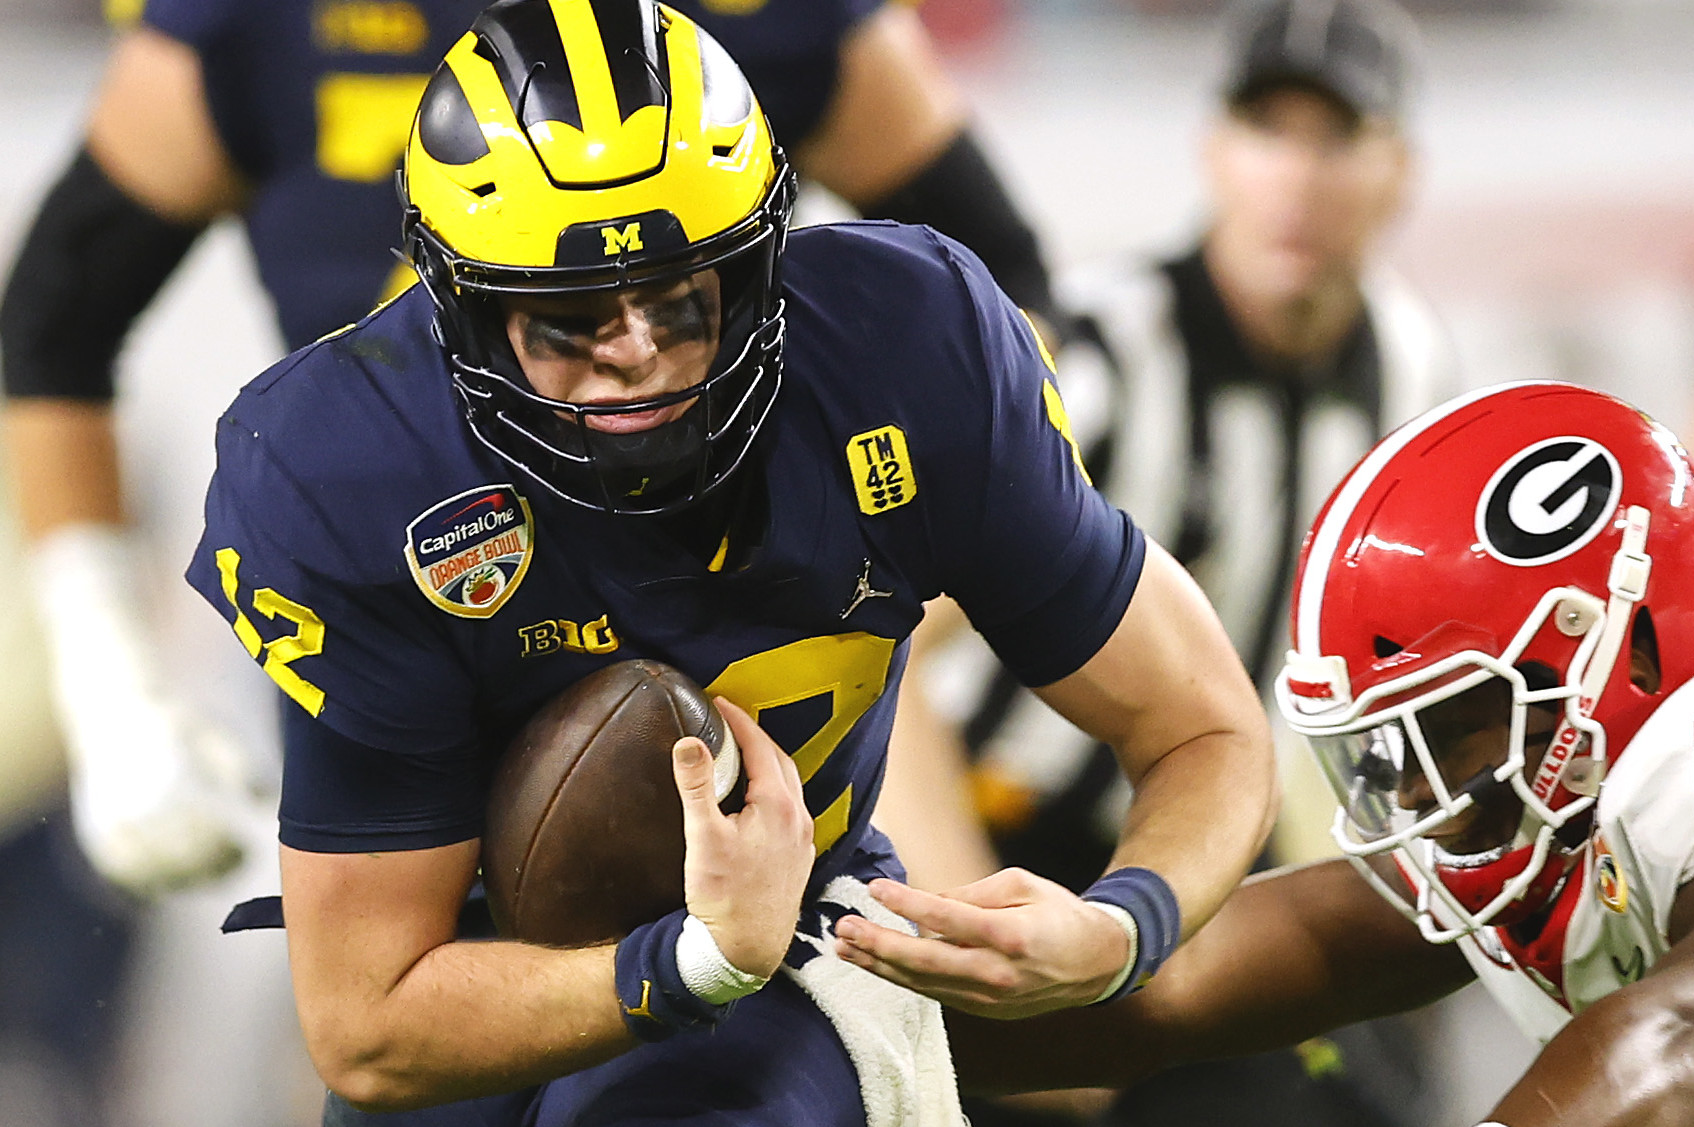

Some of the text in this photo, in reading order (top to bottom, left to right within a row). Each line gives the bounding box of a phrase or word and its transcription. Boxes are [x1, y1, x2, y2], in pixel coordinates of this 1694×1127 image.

[601, 222, 644, 256] M
[857, 432, 895, 466] TM
[867, 461, 904, 489] 42
[1484, 441, 1613, 560] G
[429, 531, 524, 590] ORANGE BOWL
[215, 547, 326, 719] 12
[705, 632, 896, 858] 2
